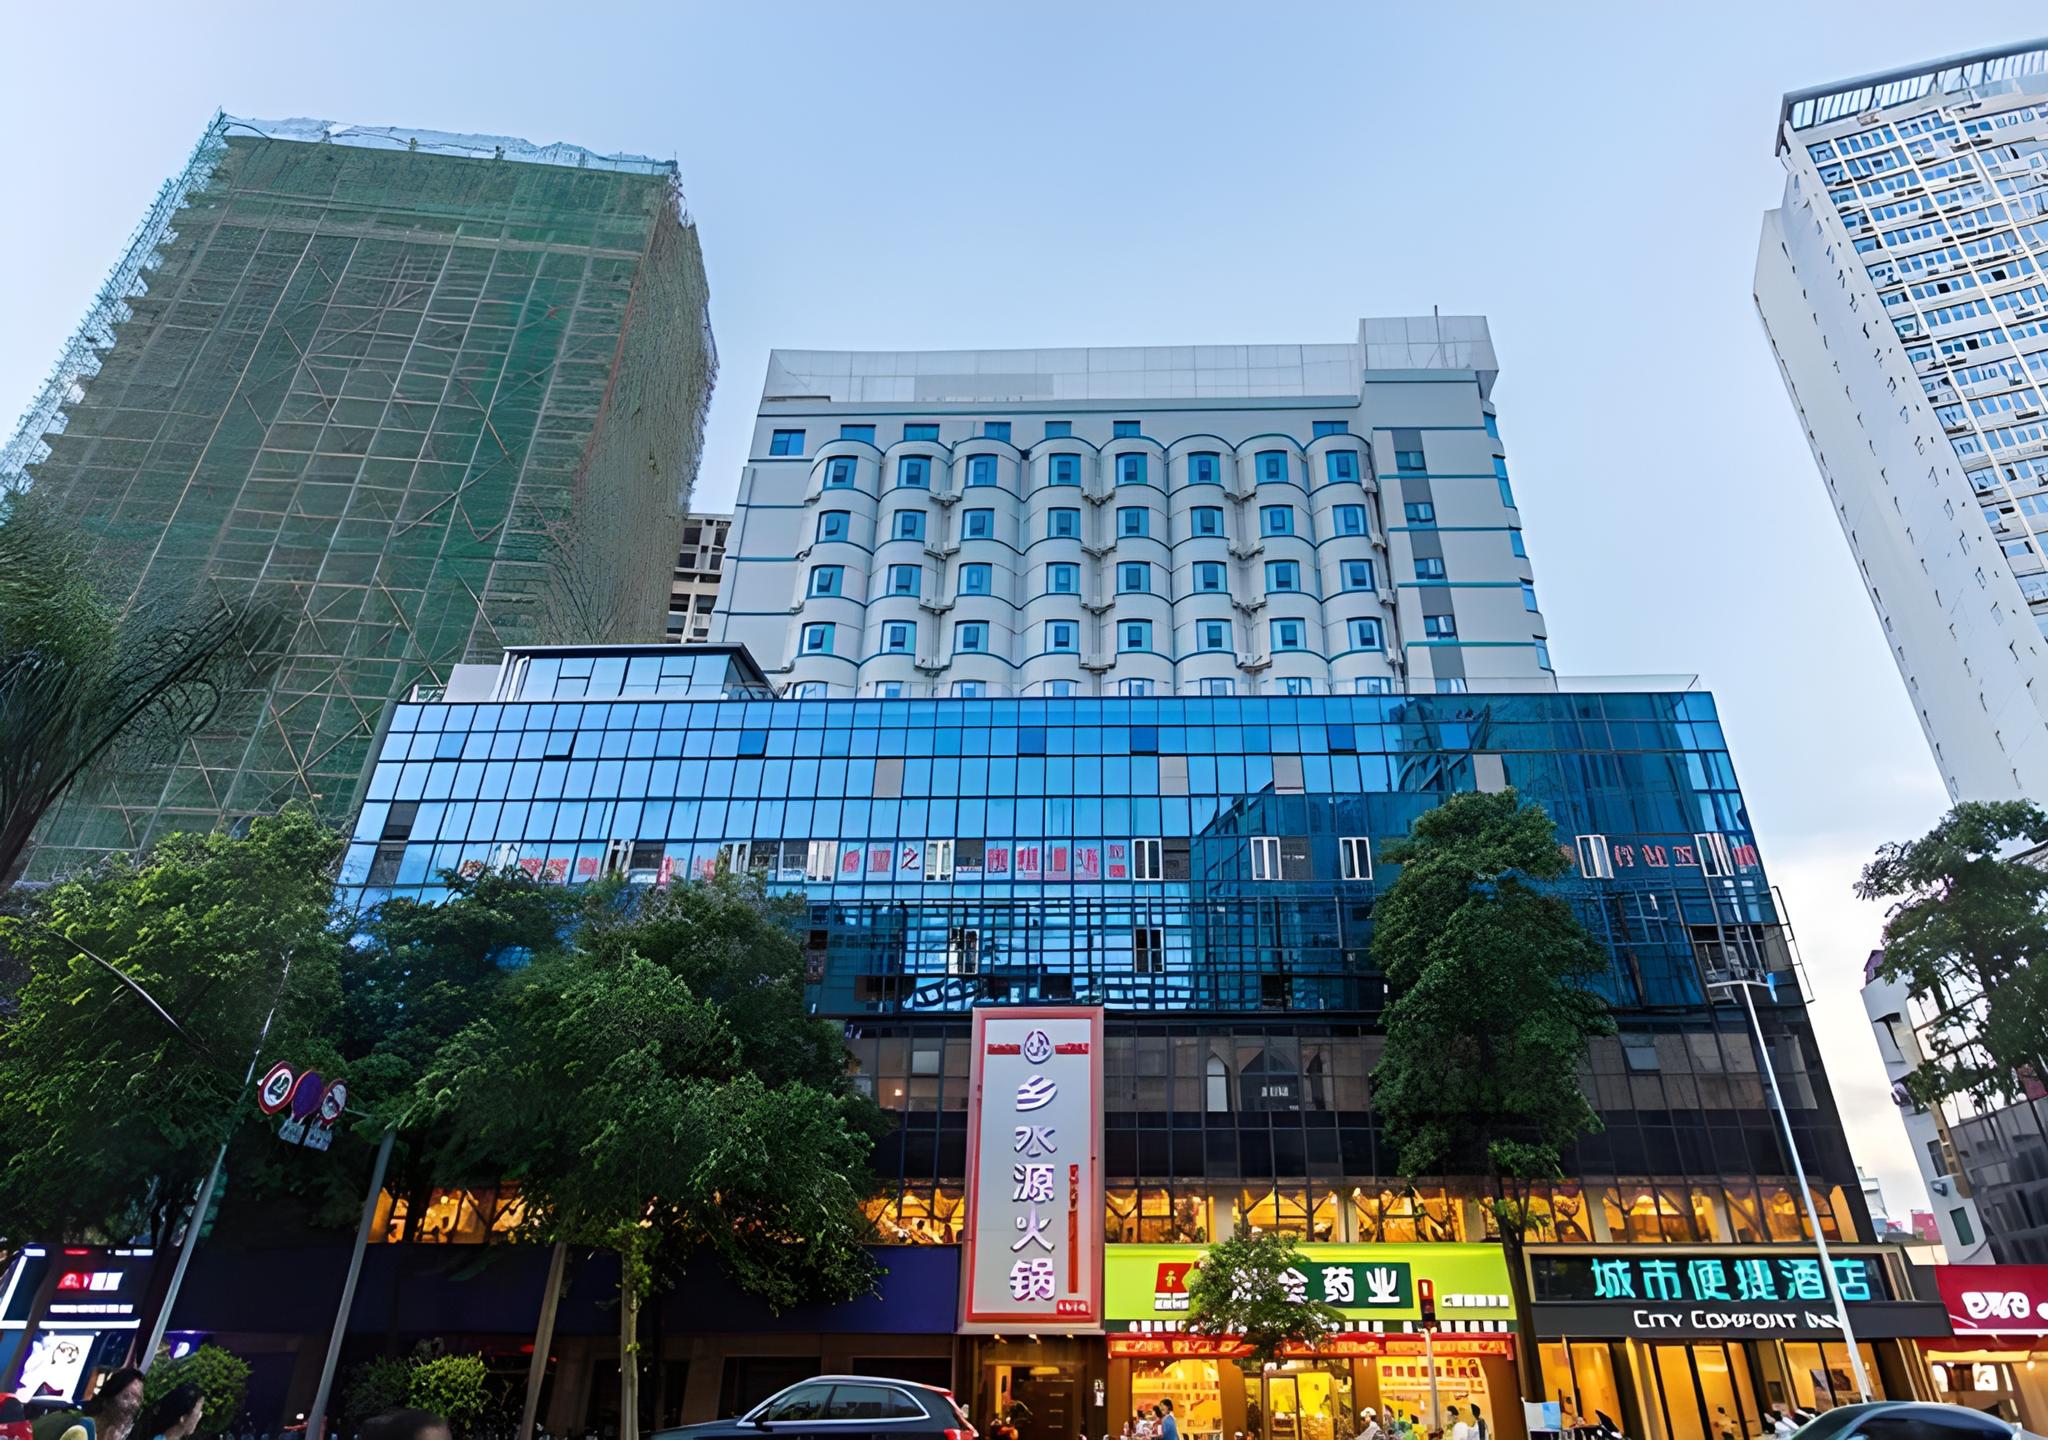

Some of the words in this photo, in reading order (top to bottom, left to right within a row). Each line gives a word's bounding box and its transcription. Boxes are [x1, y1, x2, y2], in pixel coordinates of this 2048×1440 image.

[1591, 1258, 1871, 1301] 城市便捷酒店
